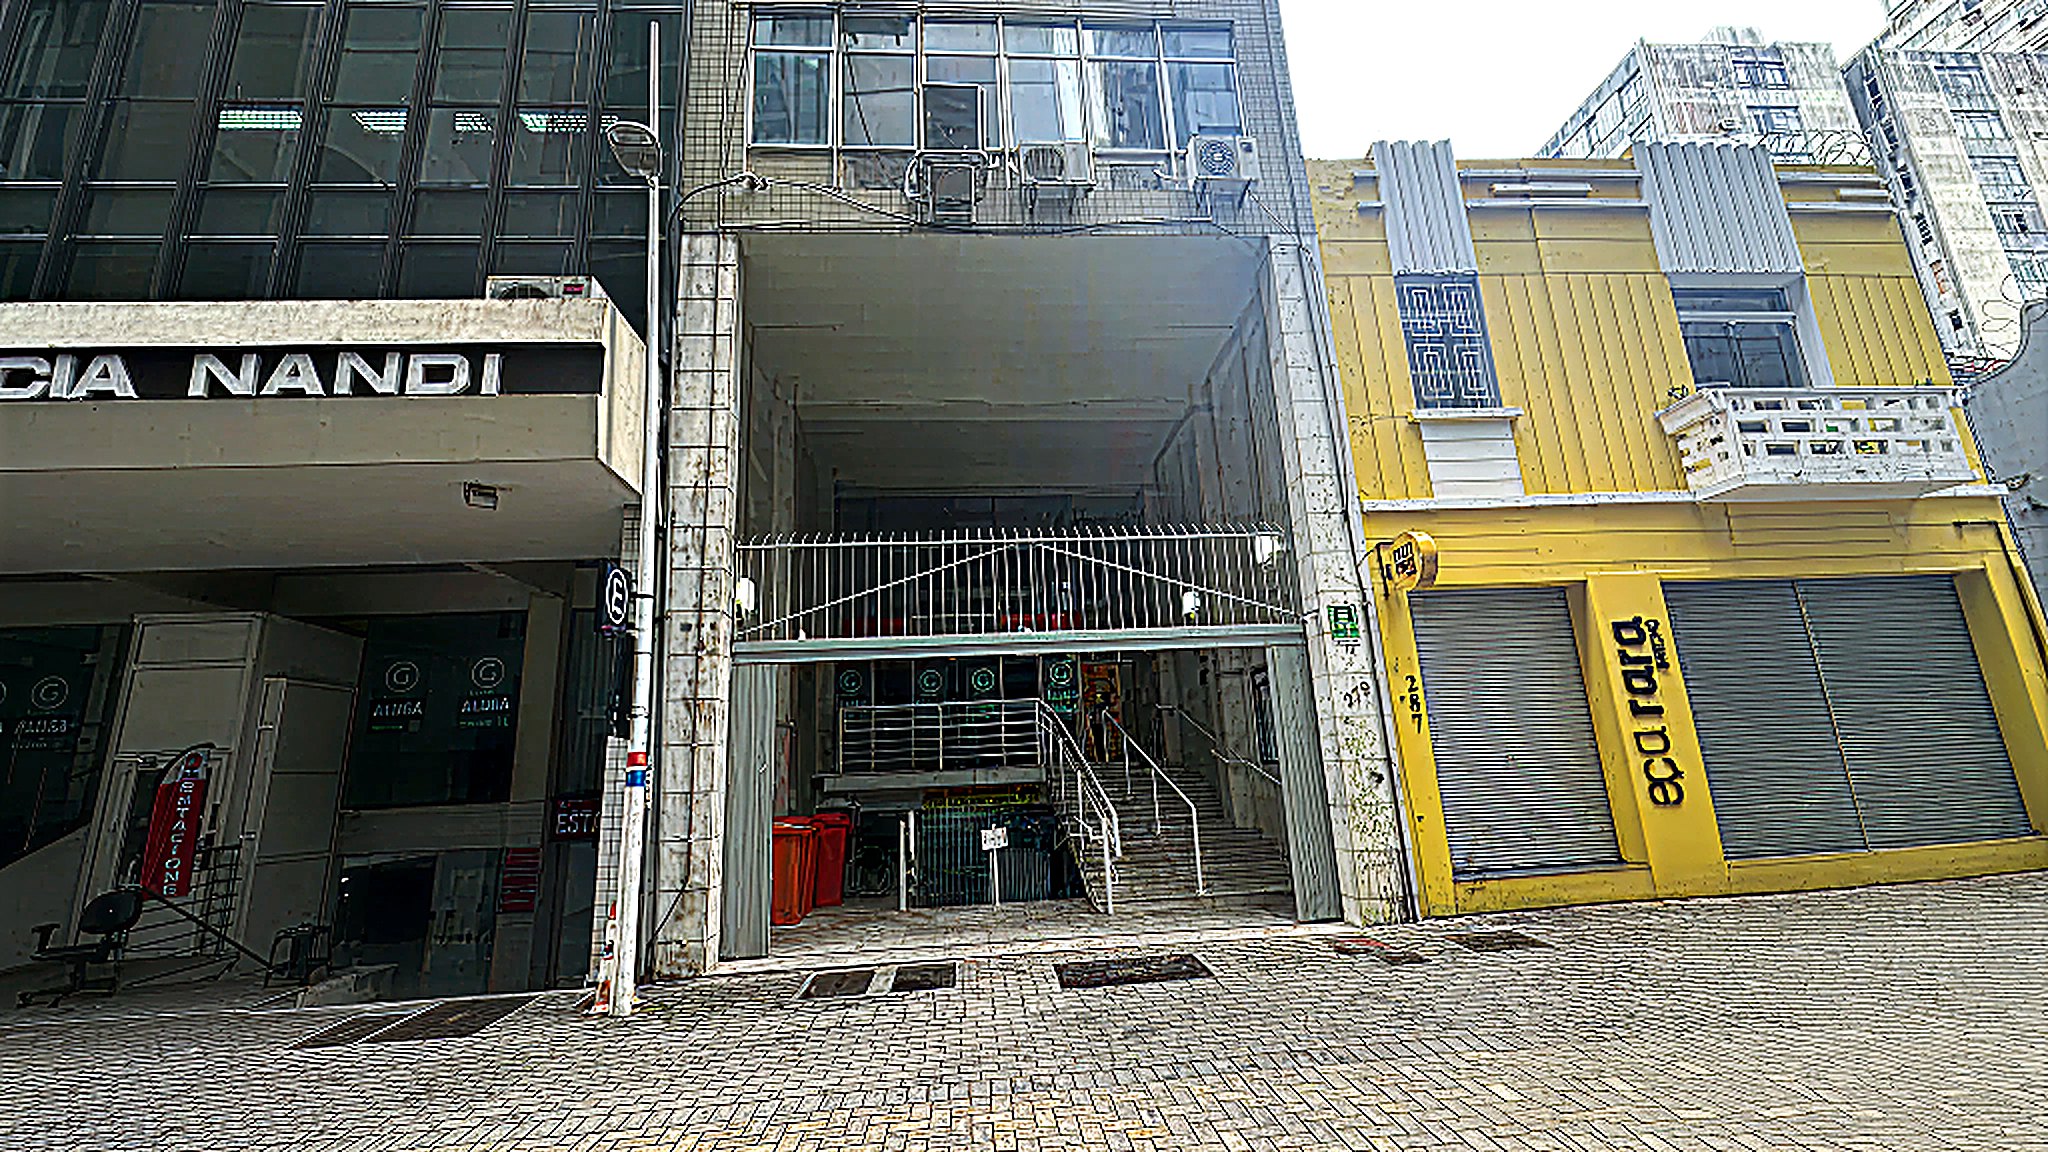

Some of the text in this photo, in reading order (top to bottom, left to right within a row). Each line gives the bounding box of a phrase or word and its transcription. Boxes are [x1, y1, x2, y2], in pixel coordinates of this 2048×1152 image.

[0, 352, 500, 399] CIA NANDI
[1405, 675, 1423, 734] 287
